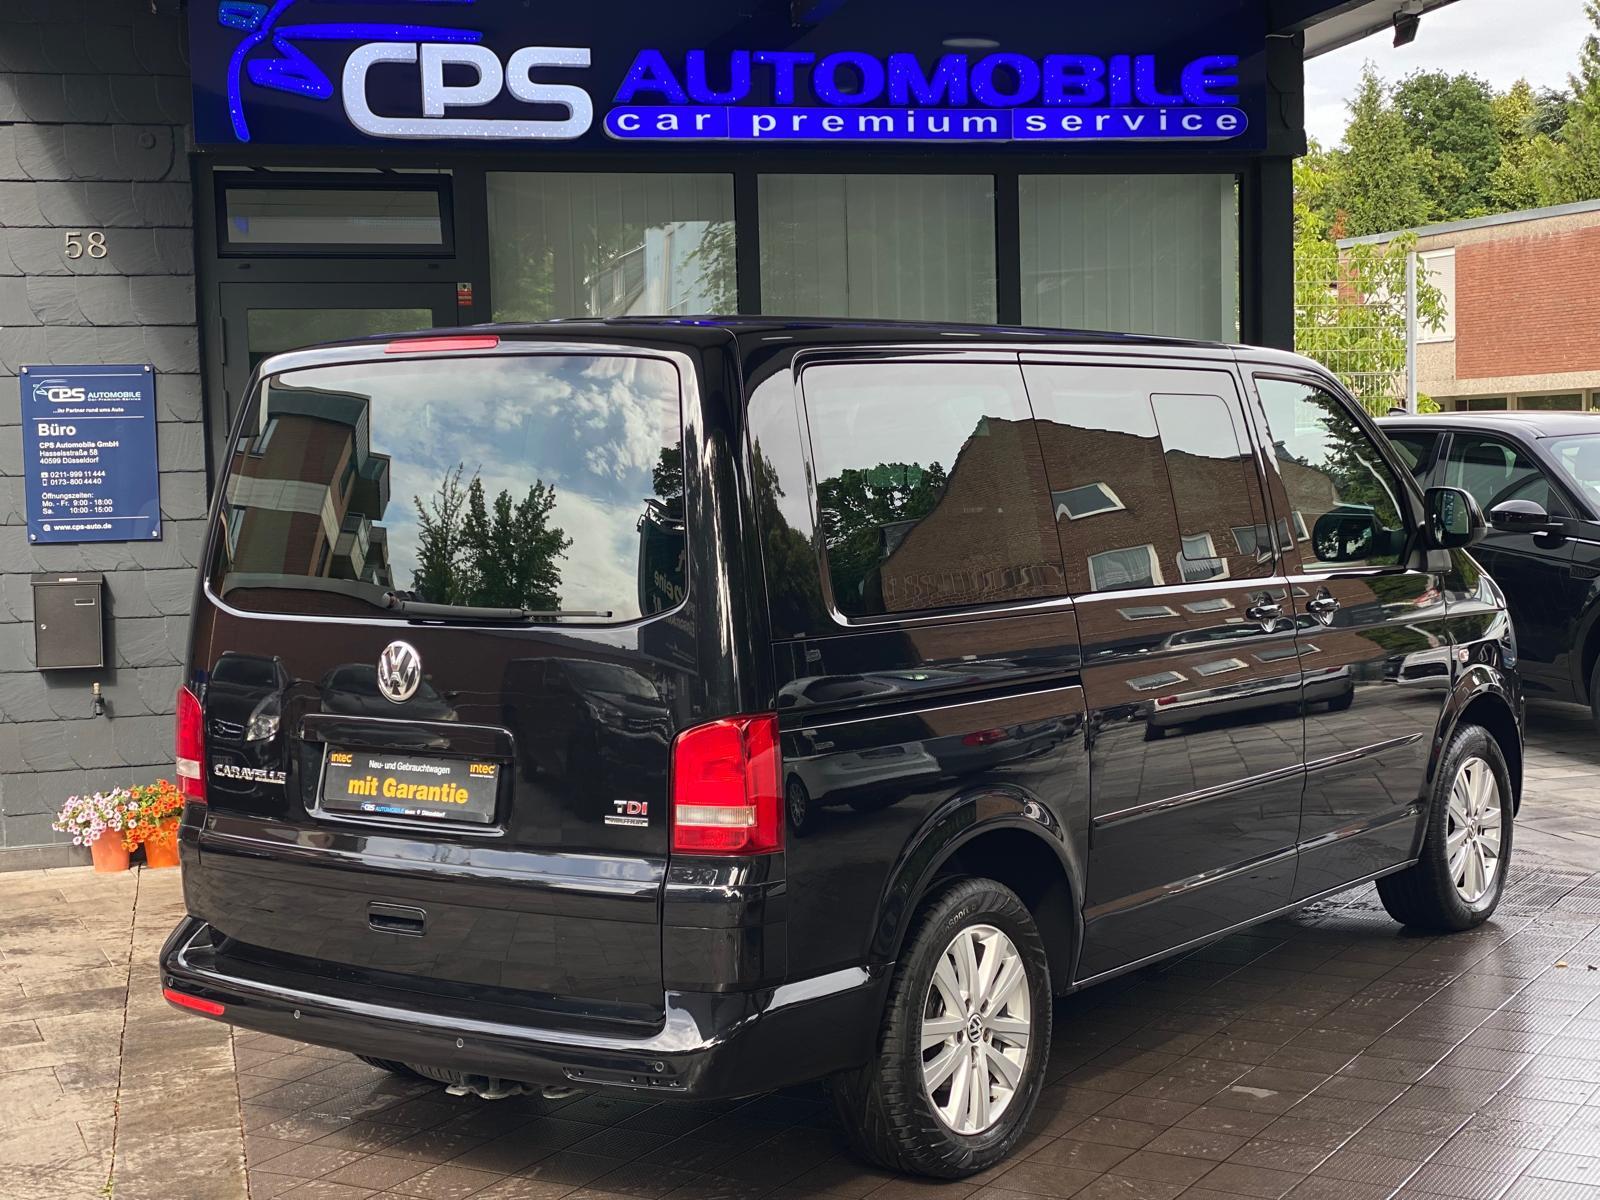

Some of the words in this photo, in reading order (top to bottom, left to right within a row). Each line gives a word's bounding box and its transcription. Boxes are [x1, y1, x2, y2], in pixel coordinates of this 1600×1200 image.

[341, 42, 594, 140] CPS
[612, 49, 1241, 108] AUTOMOBILE
[616, 110, 712, 132] car
[751, 109, 999, 137] premium
[1025, 108, 1239, 132] service
[64, 231, 107, 259] 58
[47, 388, 86, 403] CPS
[37, 423, 77, 437] Büro
[39, 441, 55, 449] CPS
[96, 440, 119, 448] GmbH
[89, 448, 98, 456] 58
[62, 456, 99, 464] Düsseldorf
[41, 491, 94, 500] Öffnungszeiten:
[331, 752, 353, 763] intec
[213, 763, 287, 785] CARAVELLE
[368, 759, 385, 770] Neu-
[384, 761, 397, 771] und
[397, 761, 451, 776] Gebrauchtwagen
[469, 763, 496, 774] intec
[347, 775, 379, 796] mit
[382, 777, 469, 805] Garantie
[613, 799, 648, 815] TDI
